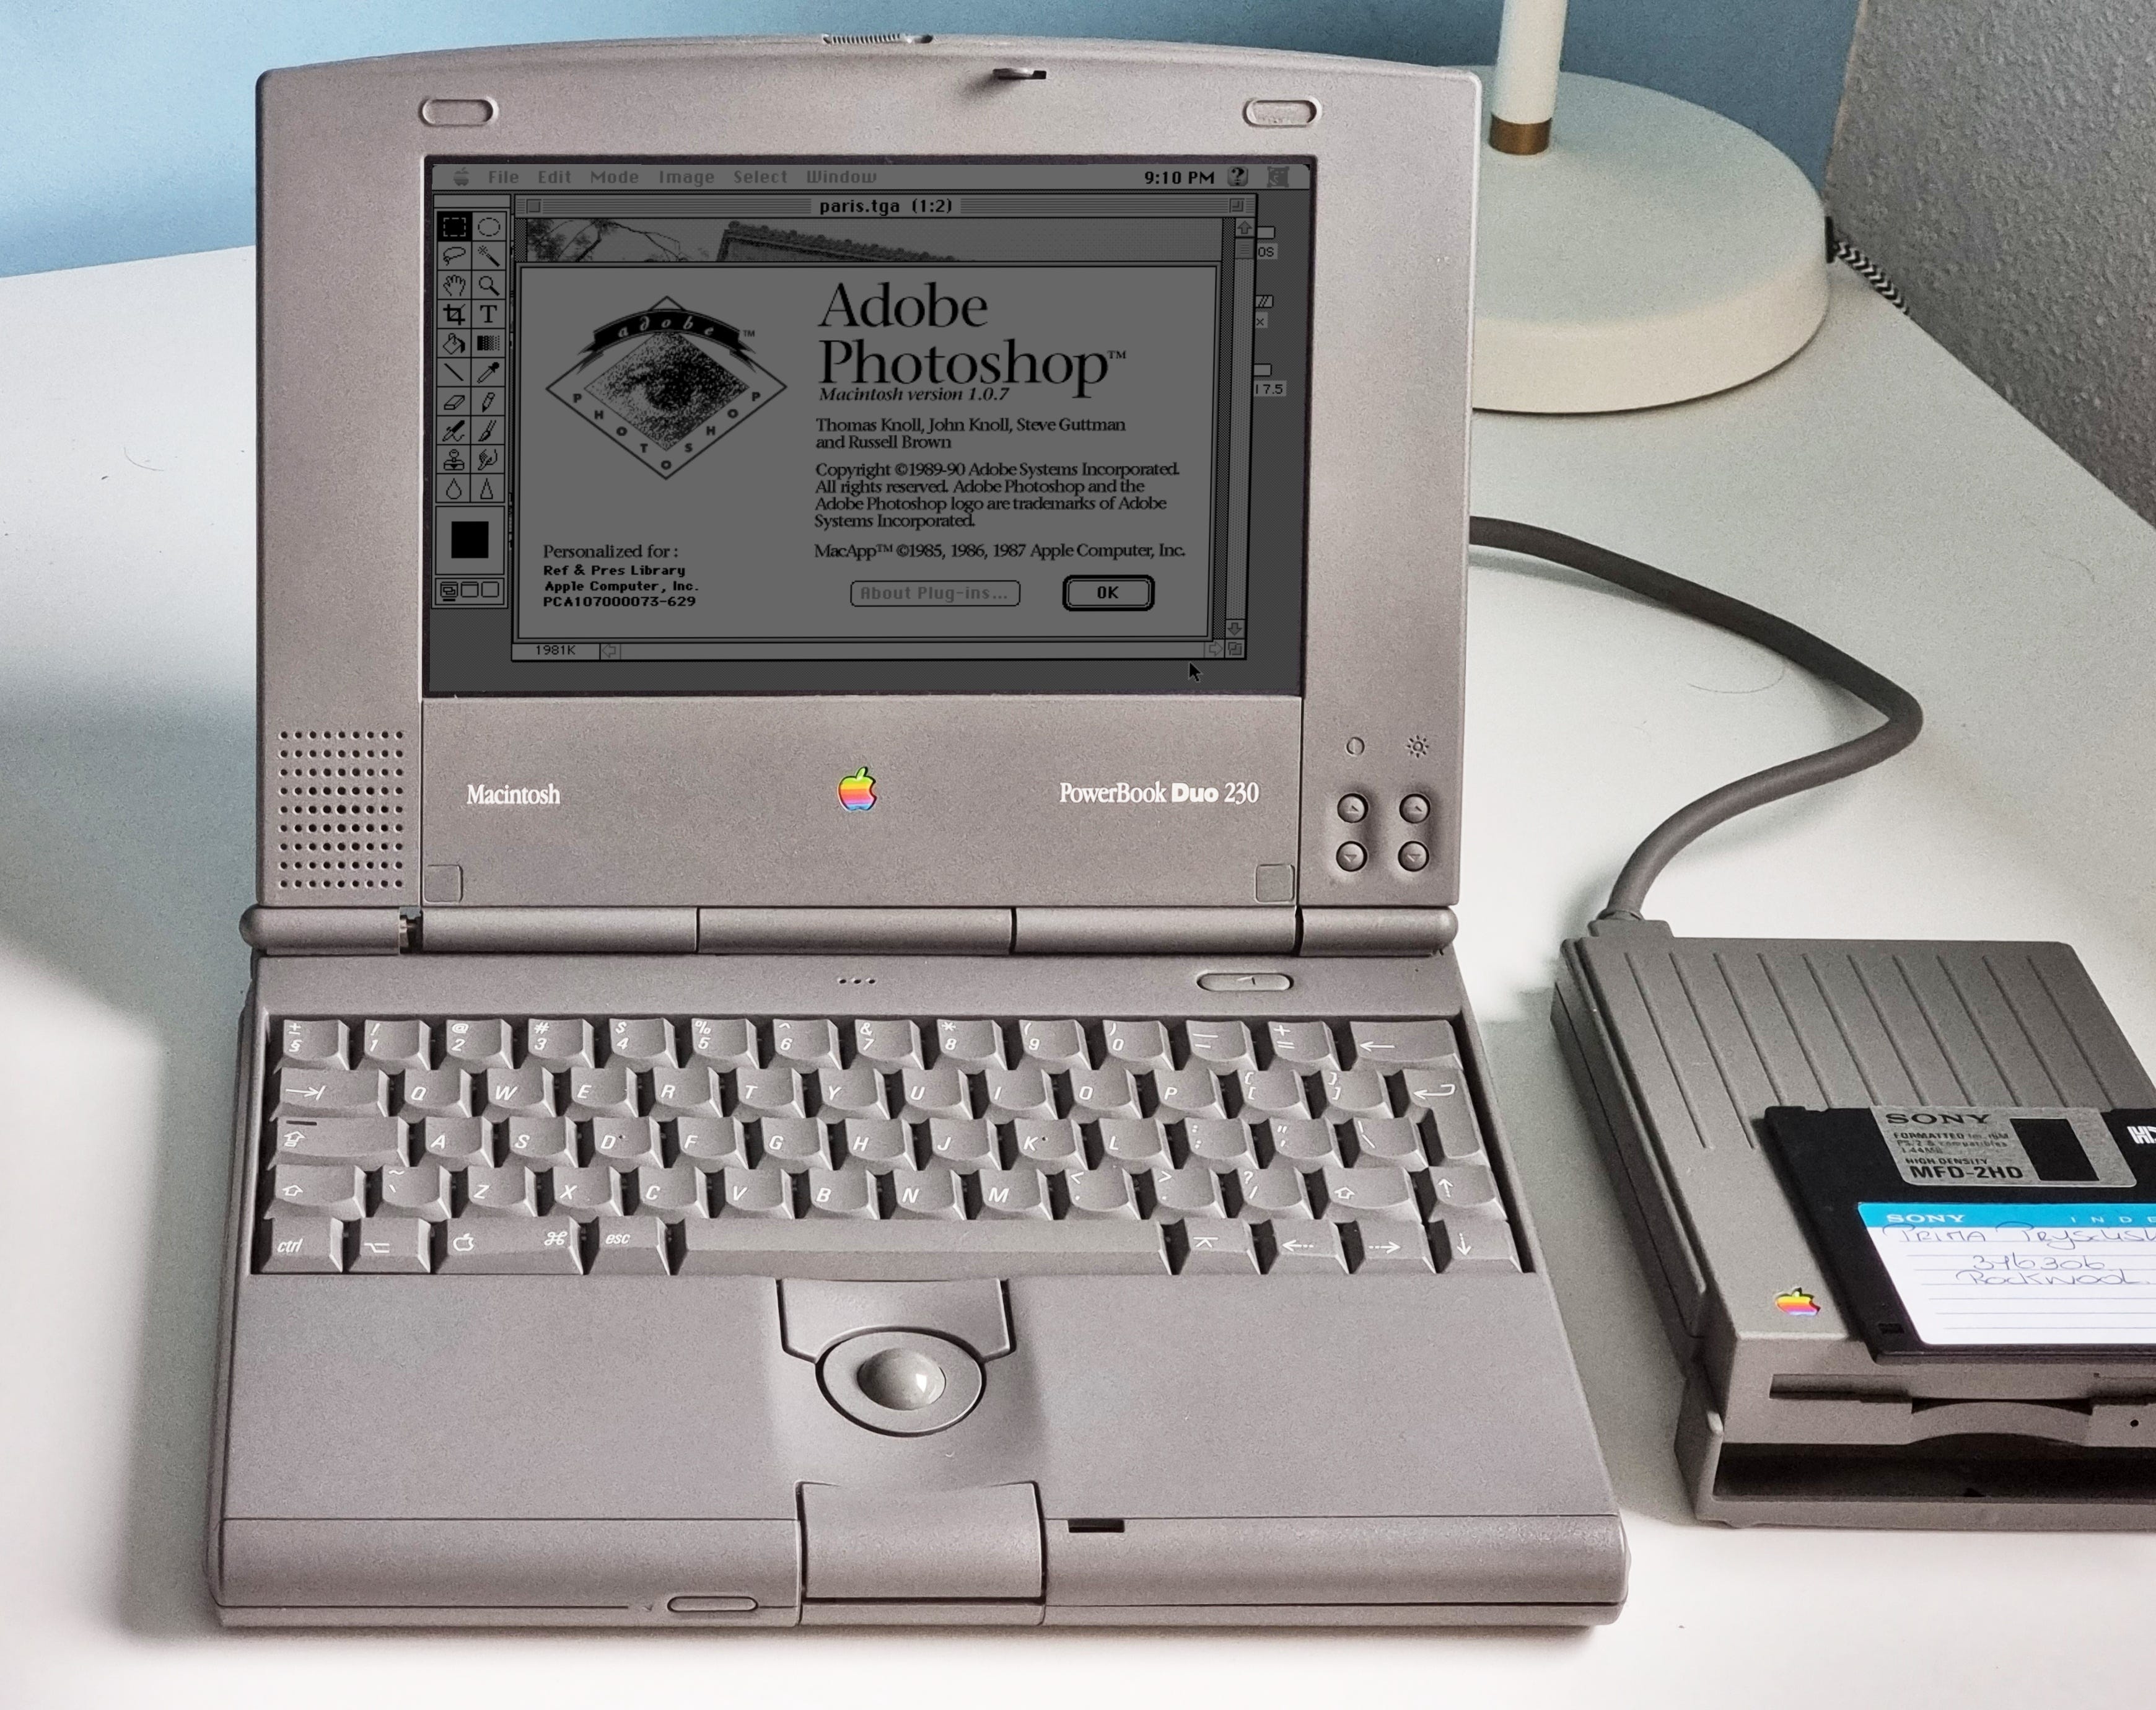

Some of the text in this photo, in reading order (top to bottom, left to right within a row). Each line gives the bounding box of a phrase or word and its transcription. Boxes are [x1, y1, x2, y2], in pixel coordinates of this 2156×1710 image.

[488, 169, 877, 187] File Edit Mode Image Select Window
[1144, 170, 1215, 185] 9:10 PM
[819, 198, 953, 216] paris.tga (1:2)
[818, 281, 989, 328] Adobe
[618, 316, 714, 338] adobe
[818, 386, 1010, 401] Macintosh version 1.0.7
[1262, 384, 1283, 394] 7.5
[816, 418, 1126, 434] Thomas Knoll, John Knoll, Steve Guttman
[815, 435, 952, 449] and Russell Brown
[815, 462, 1180, 480] Copyright ©1989-90 Adobe Systems Incorporated.
[815, 479, 1146, 497] All rights reserved. Adobe Photoshop and the
[815, 496, 1167, 514] Adobe Photoshop logo are trademarks of Adobe
[814, 514, 976, 532] Systems Incorporated.
[543, 545, 643, 559] Personalized
[647, 545, 670, 558] for
[896, 543, 946, 560] ©1985,
[951, 543, 988, 560] 1986,
[993, 543, 1027, 557] 1987
[1030, 543, 1074, 561] Apple
[1077, 543, 1155, 561] Computer,
[1159, 543, 1186, 557] Inc.
[543, 564, 686, 578] Ref & Pres Library
[545, 580, 699, 594] Apple Computer, Inc.
[860, 585, 912, 600] About
[1097, 585, 1120, 600] OK
[543, 596, 697, 607] PCA107000073-629
[535, 645, 576, 656] 1981K
[467, 783, 561, 805] Macintosh
[1059, 781, 1260, 805] PowerBook Duo 230
[369, 1040, 378, 1052] 1
[450, 1039, 465, 1051] 2
[533, 1038, 548, 1051] 3
[616, 1037, 629, 1050] 4
[697, 1037, 711, 1050] 5
[779, 1038, 793, 1051] 6
[862, 1038, 875, 1051] 7
[944, 1038, 958, 1051] 8
[1028, 1038, 1041, 1051] 9
[410, 1086, 427, 1101] Q
[494, 1085, 519, 1101] W
[577, 1085, 592, 1098] E
[660, 1084, 676, 1098] R
[744, 1085, 758, 1099] T
[828, 1085, 842, 1101] Y
[910, 1086, 926, 1101] U
[993, 1086, 1002, 1100] I
[1078, 1085, 1094, 1101] O
[1163, 1087, 1178, 1101] P
[1885, 1113, 1991, 1125] SONY
[430, 1134, 446, 1149] A
[514, 1134, 531, 1149] S
[600, 1135, 616, 1150] D
[683, 1135, 698, 1150] F
[768, 1135, 785, 1151] G
[852, 1136, 870, 1152] H
[937, 1136, 952, 1151] J
[1023, 1136, 1039, 1151] K
[1108, 1136, 1119, 1151] L
[1909, 1165, 2024, 1178] MFD-2HD
[473, 1184, 490, 1199] Z
[559, 1185, 577, 1199] X
[646, 1185, 661, 1200] C
[732, 1186, 748, 1201] V
[815, 1188, 832, 1203] B
[901, 1188, 920, 1204] N
[988, 1188, 1010, 1203] M
[1886, 1214, 1966, 1224] SONY
[276, 1238, 304, 1253] ctrl
[605, 1232, 631, 1245] esc
